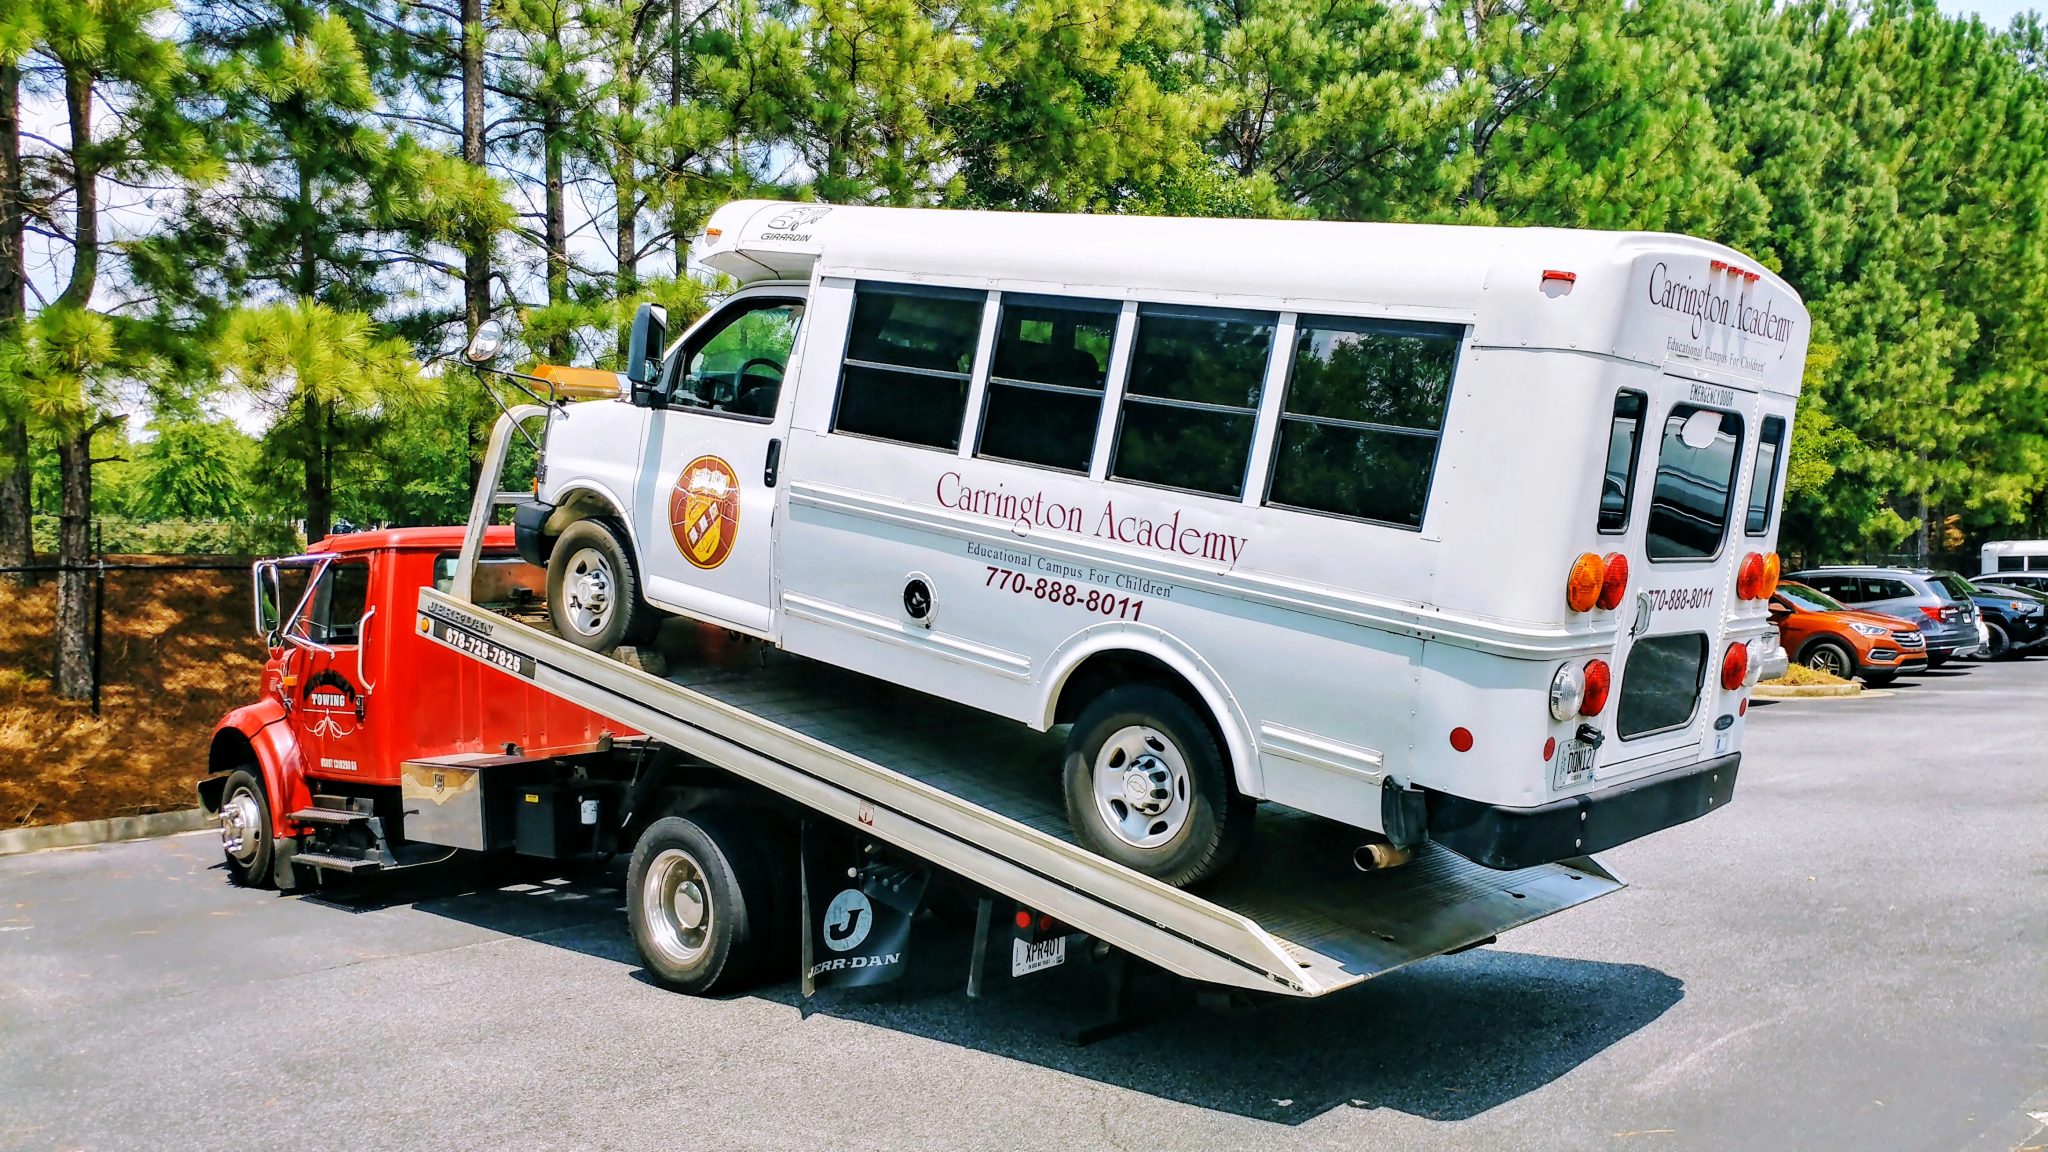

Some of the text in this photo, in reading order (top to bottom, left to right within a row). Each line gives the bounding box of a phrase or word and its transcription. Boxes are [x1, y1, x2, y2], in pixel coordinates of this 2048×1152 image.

[760, 232, 812, 242] GIRARDIN
[1649, 262, 1795, 361] Carrington Academy
[1666, 336, 1703, 358] Educational
[1704, 346, 1727, 366] Campus
[1729, 353, 1739, 367] For
[936, 471, 1248, 577] Carrington Academy
[967, 541, 1032, 567] Educational
[1037, 557, 1083, 578] Campus
[1088, 568, 1110, 584] For
[985, 566, 1144, 622] 770-888-8011
[445, 627, 521, 672] 678-725-7825
[311, 693, 346, 707] TOWING
[807, 952, 901, 979] JERR-DAN
